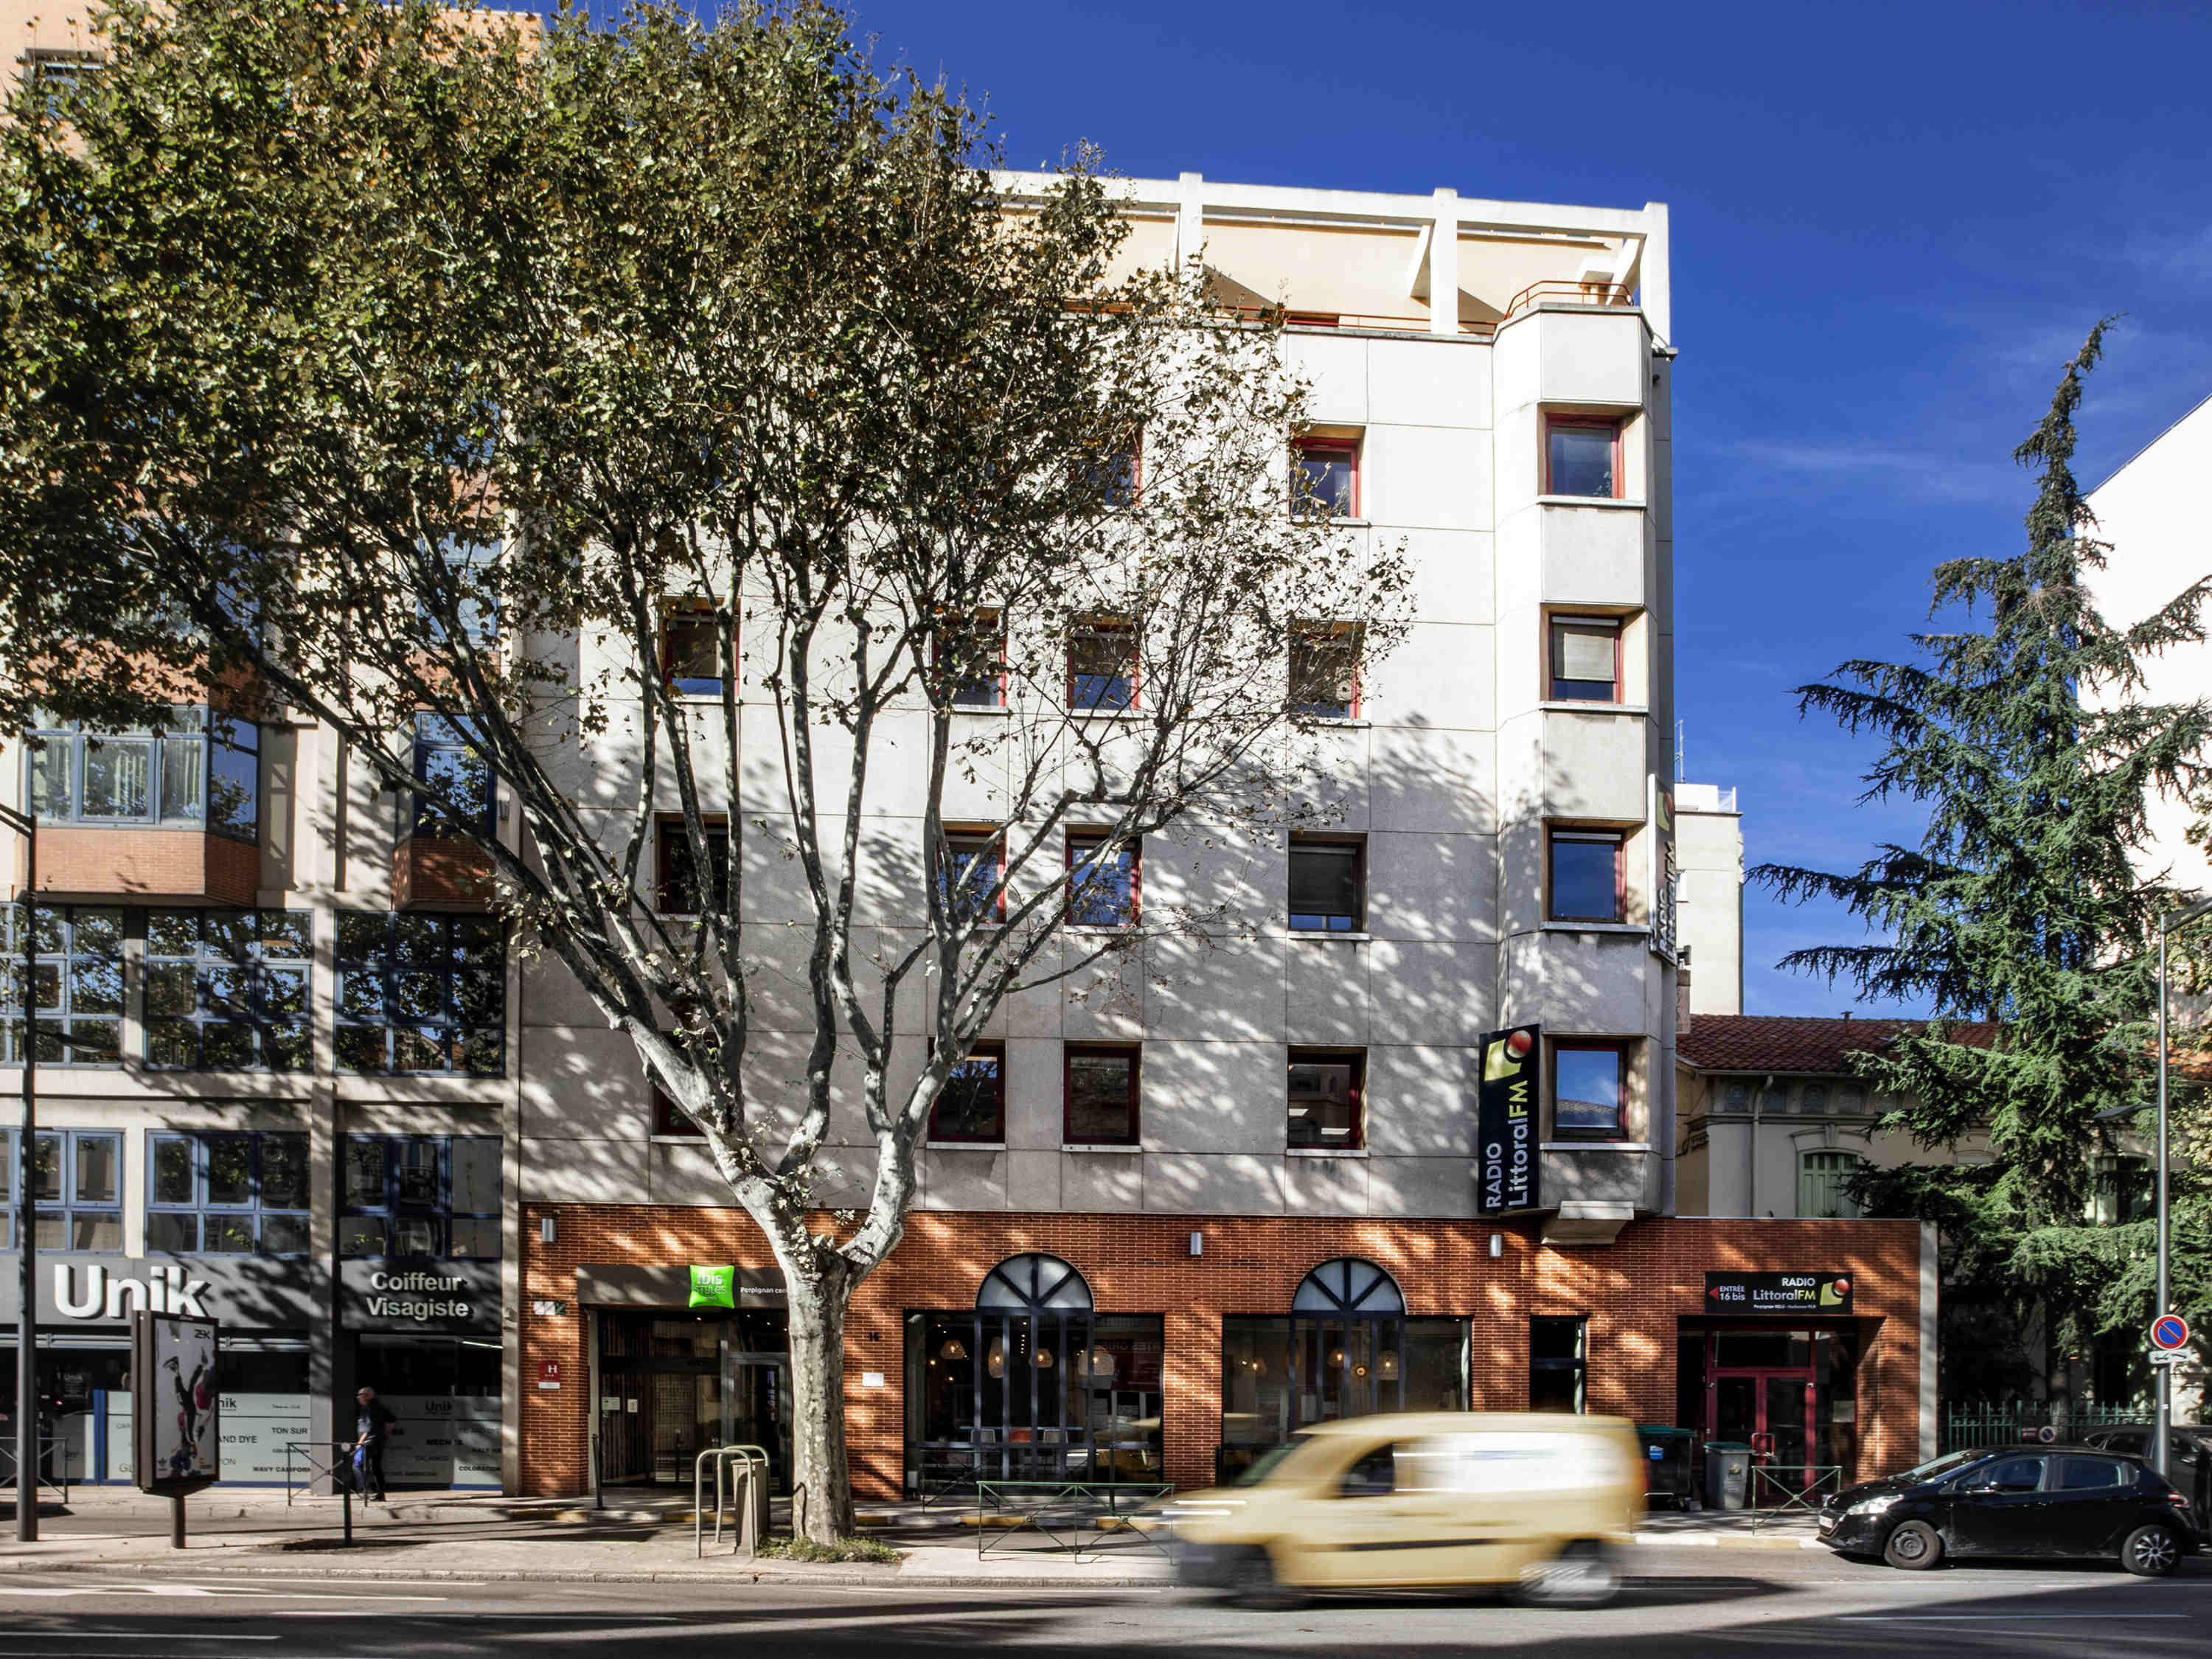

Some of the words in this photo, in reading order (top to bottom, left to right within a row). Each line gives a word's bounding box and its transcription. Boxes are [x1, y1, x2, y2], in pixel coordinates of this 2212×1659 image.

[1509, 1079, 1528, 1206] LittoralFM
[1486, 1143, 1503, 1208] RADIO
[371, 1272, 462, 1290] Coiffeur
[698, 1272, 723, 1285] ibis
[1781, 1278, 1815, 1287] RADIO
[54, 1264, 208, 1318] Unik
[1719, 1284, 1745, 1293] ENTRÉE
[1720, 1293, 1729, 1301] 16
[1733, 1293, 1745, 1301] bis
[1753, 1290, 1816, 1301] LittoralFM
[366, 1297, 470, 1321] Visagiste
[548, 1365, 557, 1374] H
[220, 1398, 237, 1408] nik
